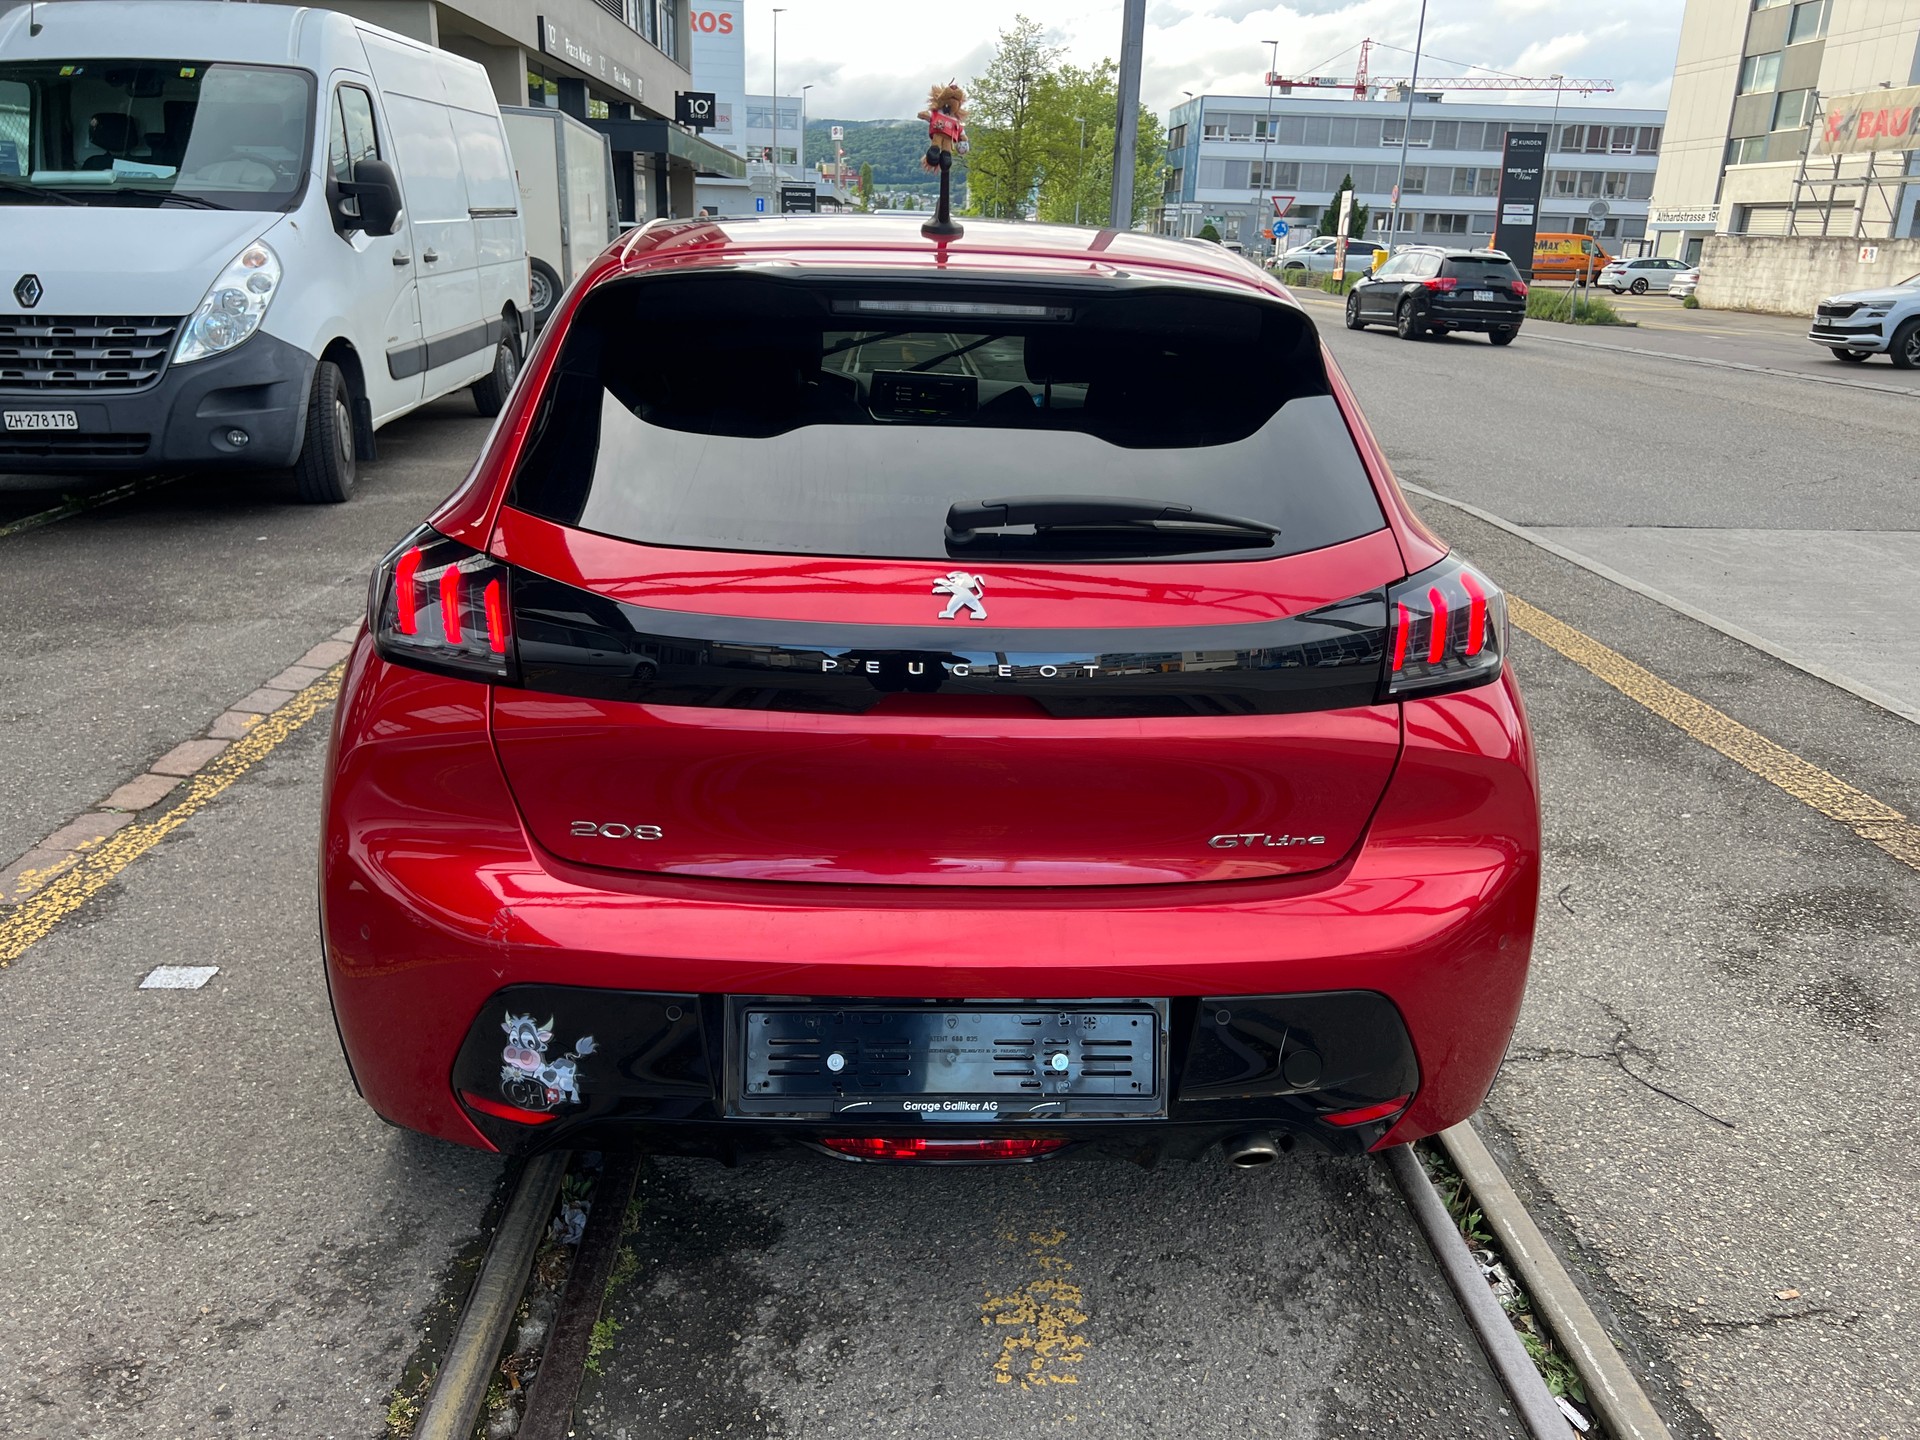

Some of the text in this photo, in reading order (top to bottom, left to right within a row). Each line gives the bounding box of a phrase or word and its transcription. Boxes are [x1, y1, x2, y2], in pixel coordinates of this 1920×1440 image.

[565, 37, 579, 60] Pizza
[1656, 211, 1706, 222] Althardstrasse
[822, 659, 1099, 678] PEUGEOT
[570, 821, 663, 840] 208
[511, 1083, 546, 1106] CH
[903, 1101, 998, 1112] Garage Galliker AG
